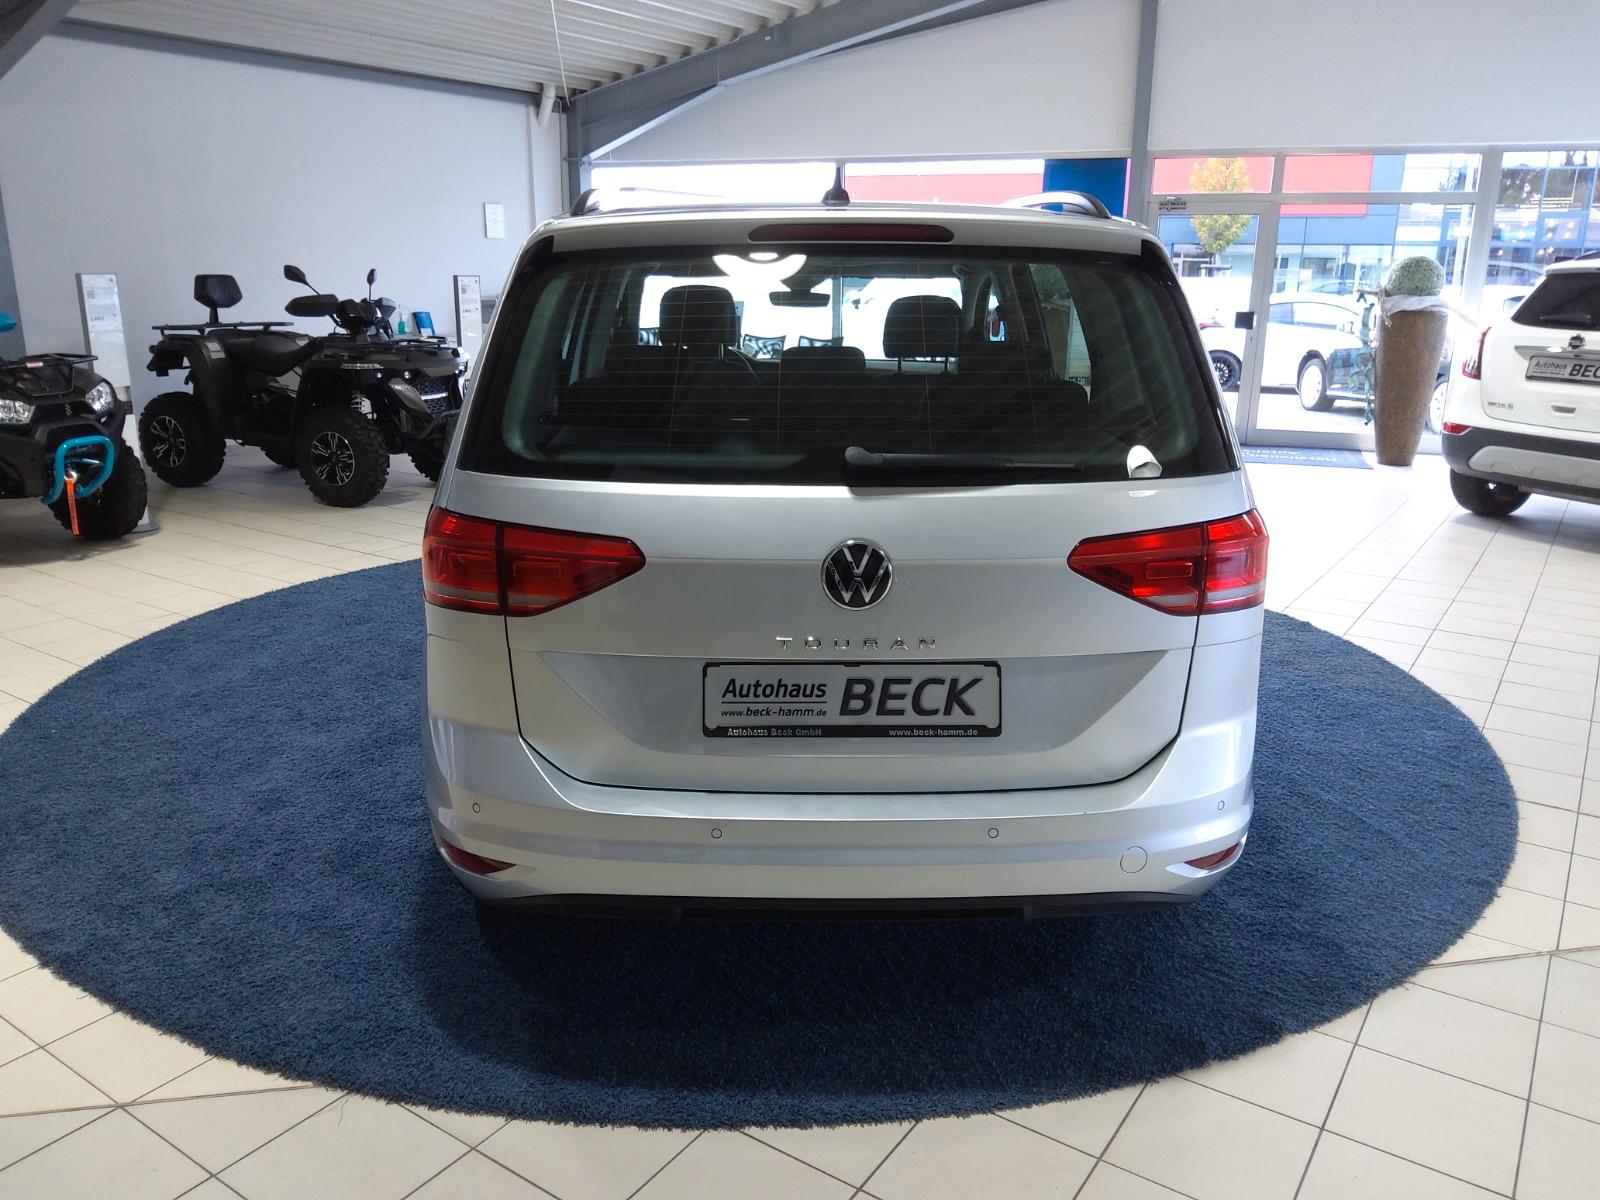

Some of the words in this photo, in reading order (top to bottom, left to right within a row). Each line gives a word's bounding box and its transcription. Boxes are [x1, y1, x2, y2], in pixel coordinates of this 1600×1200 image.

[1534, 361, 1567, 370] Autohaus
[776, 636, 936, 650] TOURAN
[721, 678, 827, 698] Autohaus
[839, 678, 983, 717] BECK
[721, 707, 827, 717] www.beck-hamm.de
[727, 728, 768, 736] Autohaus
[795, 728, 822, 736] GmbH
[888, 728, 978, 736] www.beck-hamm.de
